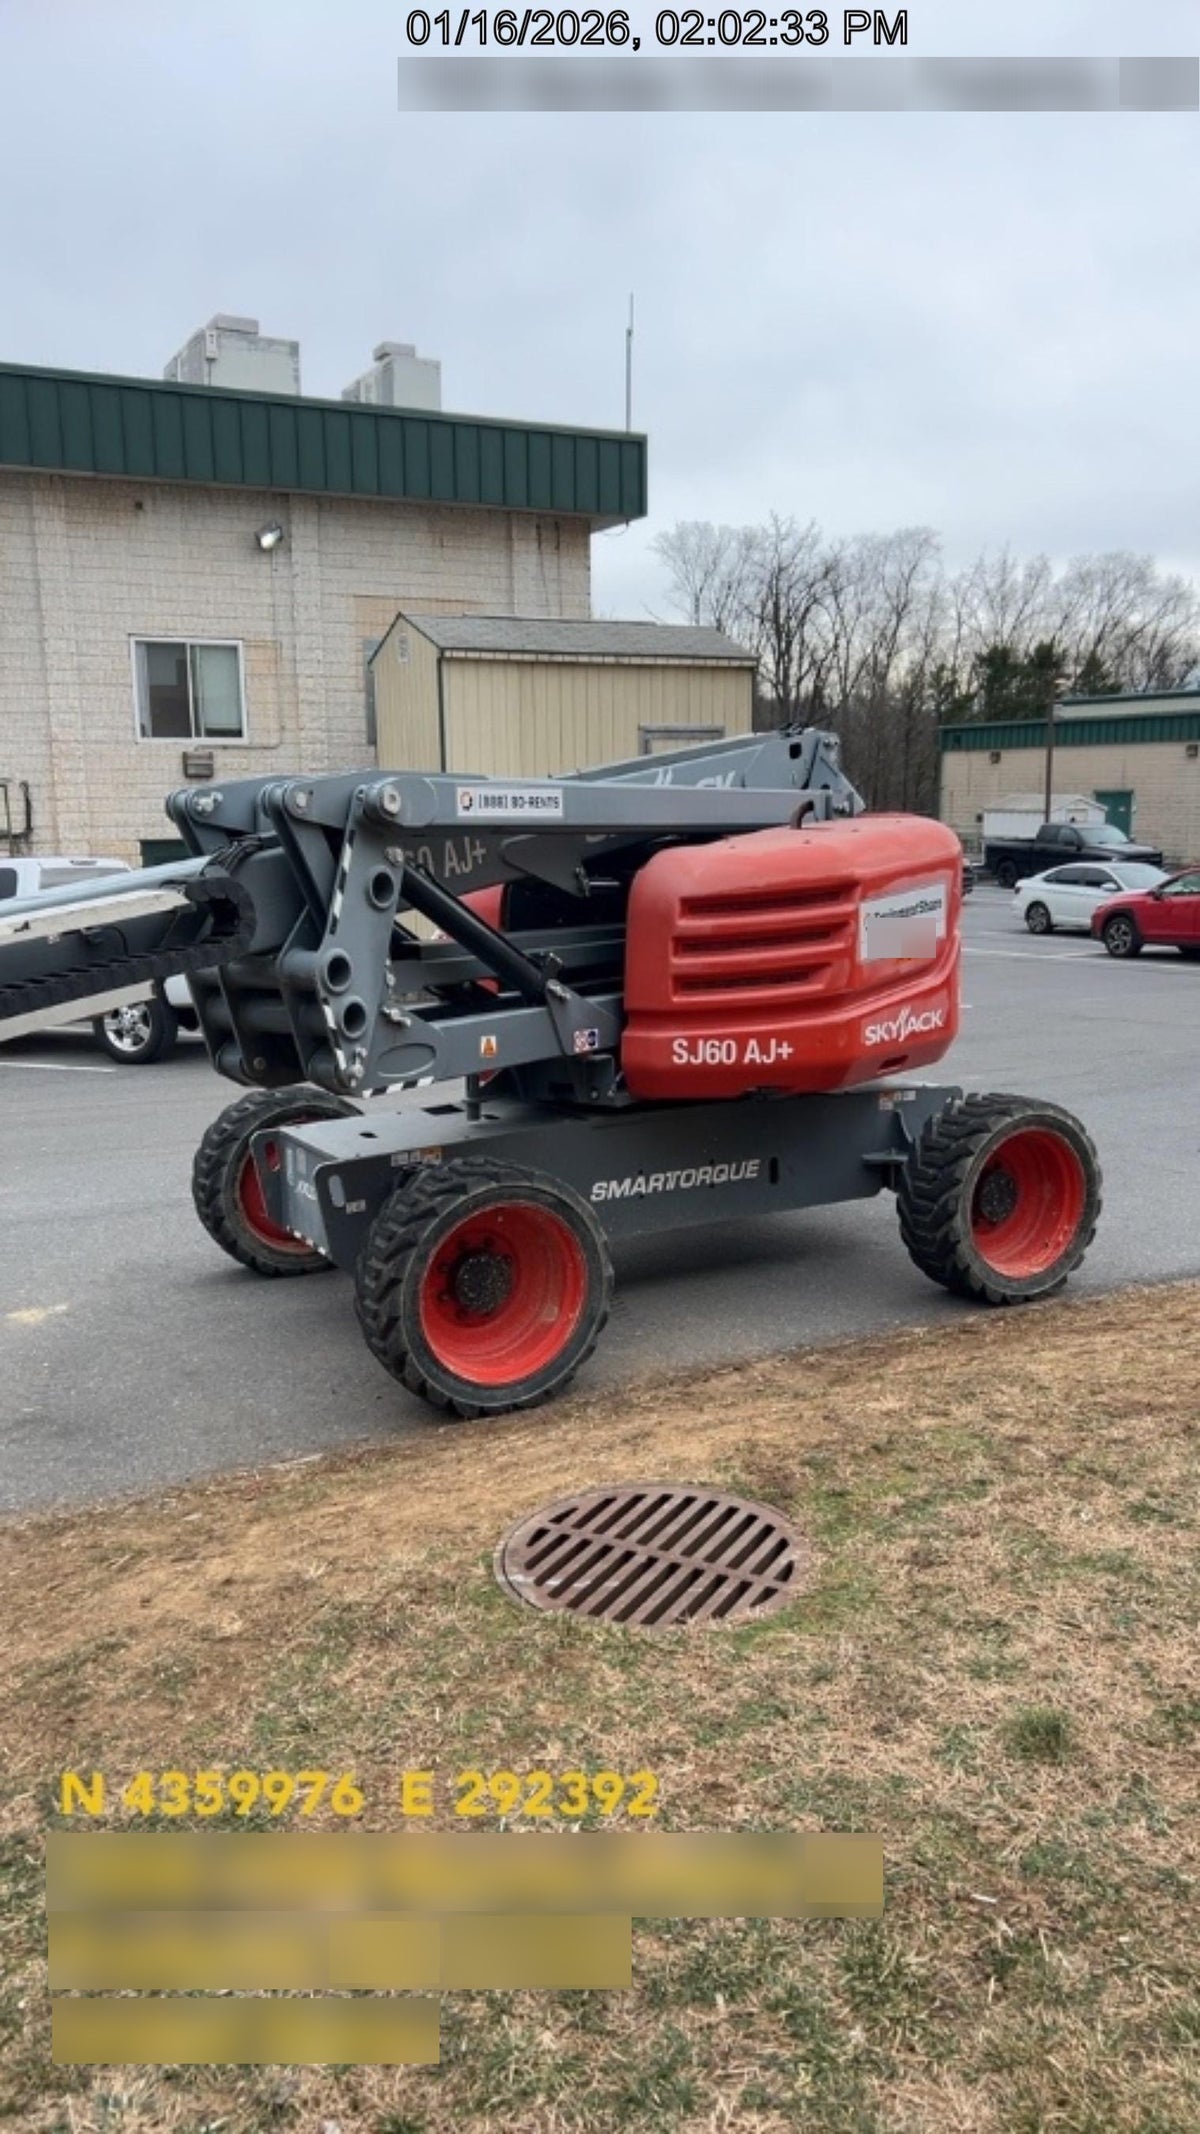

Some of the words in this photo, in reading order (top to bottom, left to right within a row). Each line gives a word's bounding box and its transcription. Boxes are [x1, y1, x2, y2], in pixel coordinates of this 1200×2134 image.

[443, 836, 487, 878] AJ+
[864, 1006, 944, 1047] SKYJACK
[672, 1038, 737, 1065] SJ60
[743, 1038, 794, 1064] AJ+
[590, 1158, 761, 1202] SMARTORQUE
